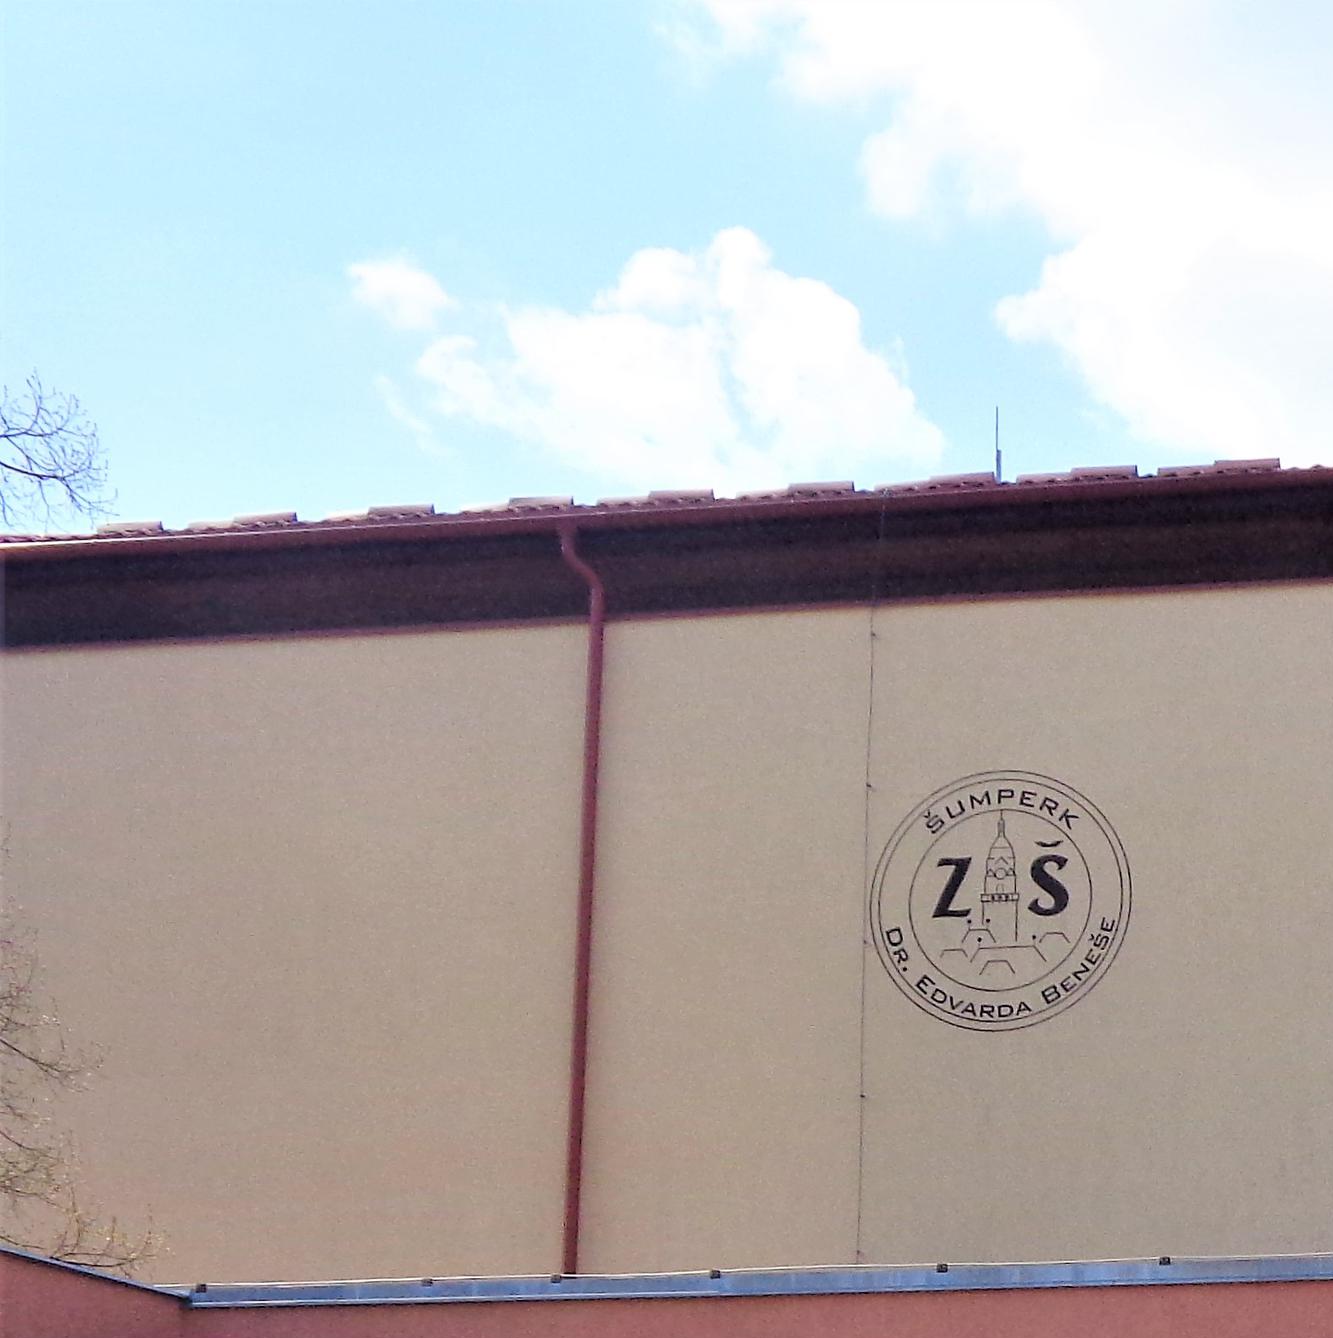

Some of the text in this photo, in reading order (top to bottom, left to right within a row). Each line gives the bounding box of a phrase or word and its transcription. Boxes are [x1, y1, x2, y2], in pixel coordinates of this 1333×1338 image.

[924, 789, 1080, 834] ŠUMPERK
[886, 927, 909, 972] DR.
[915, 974, 1032, 1018] EDVARDA
